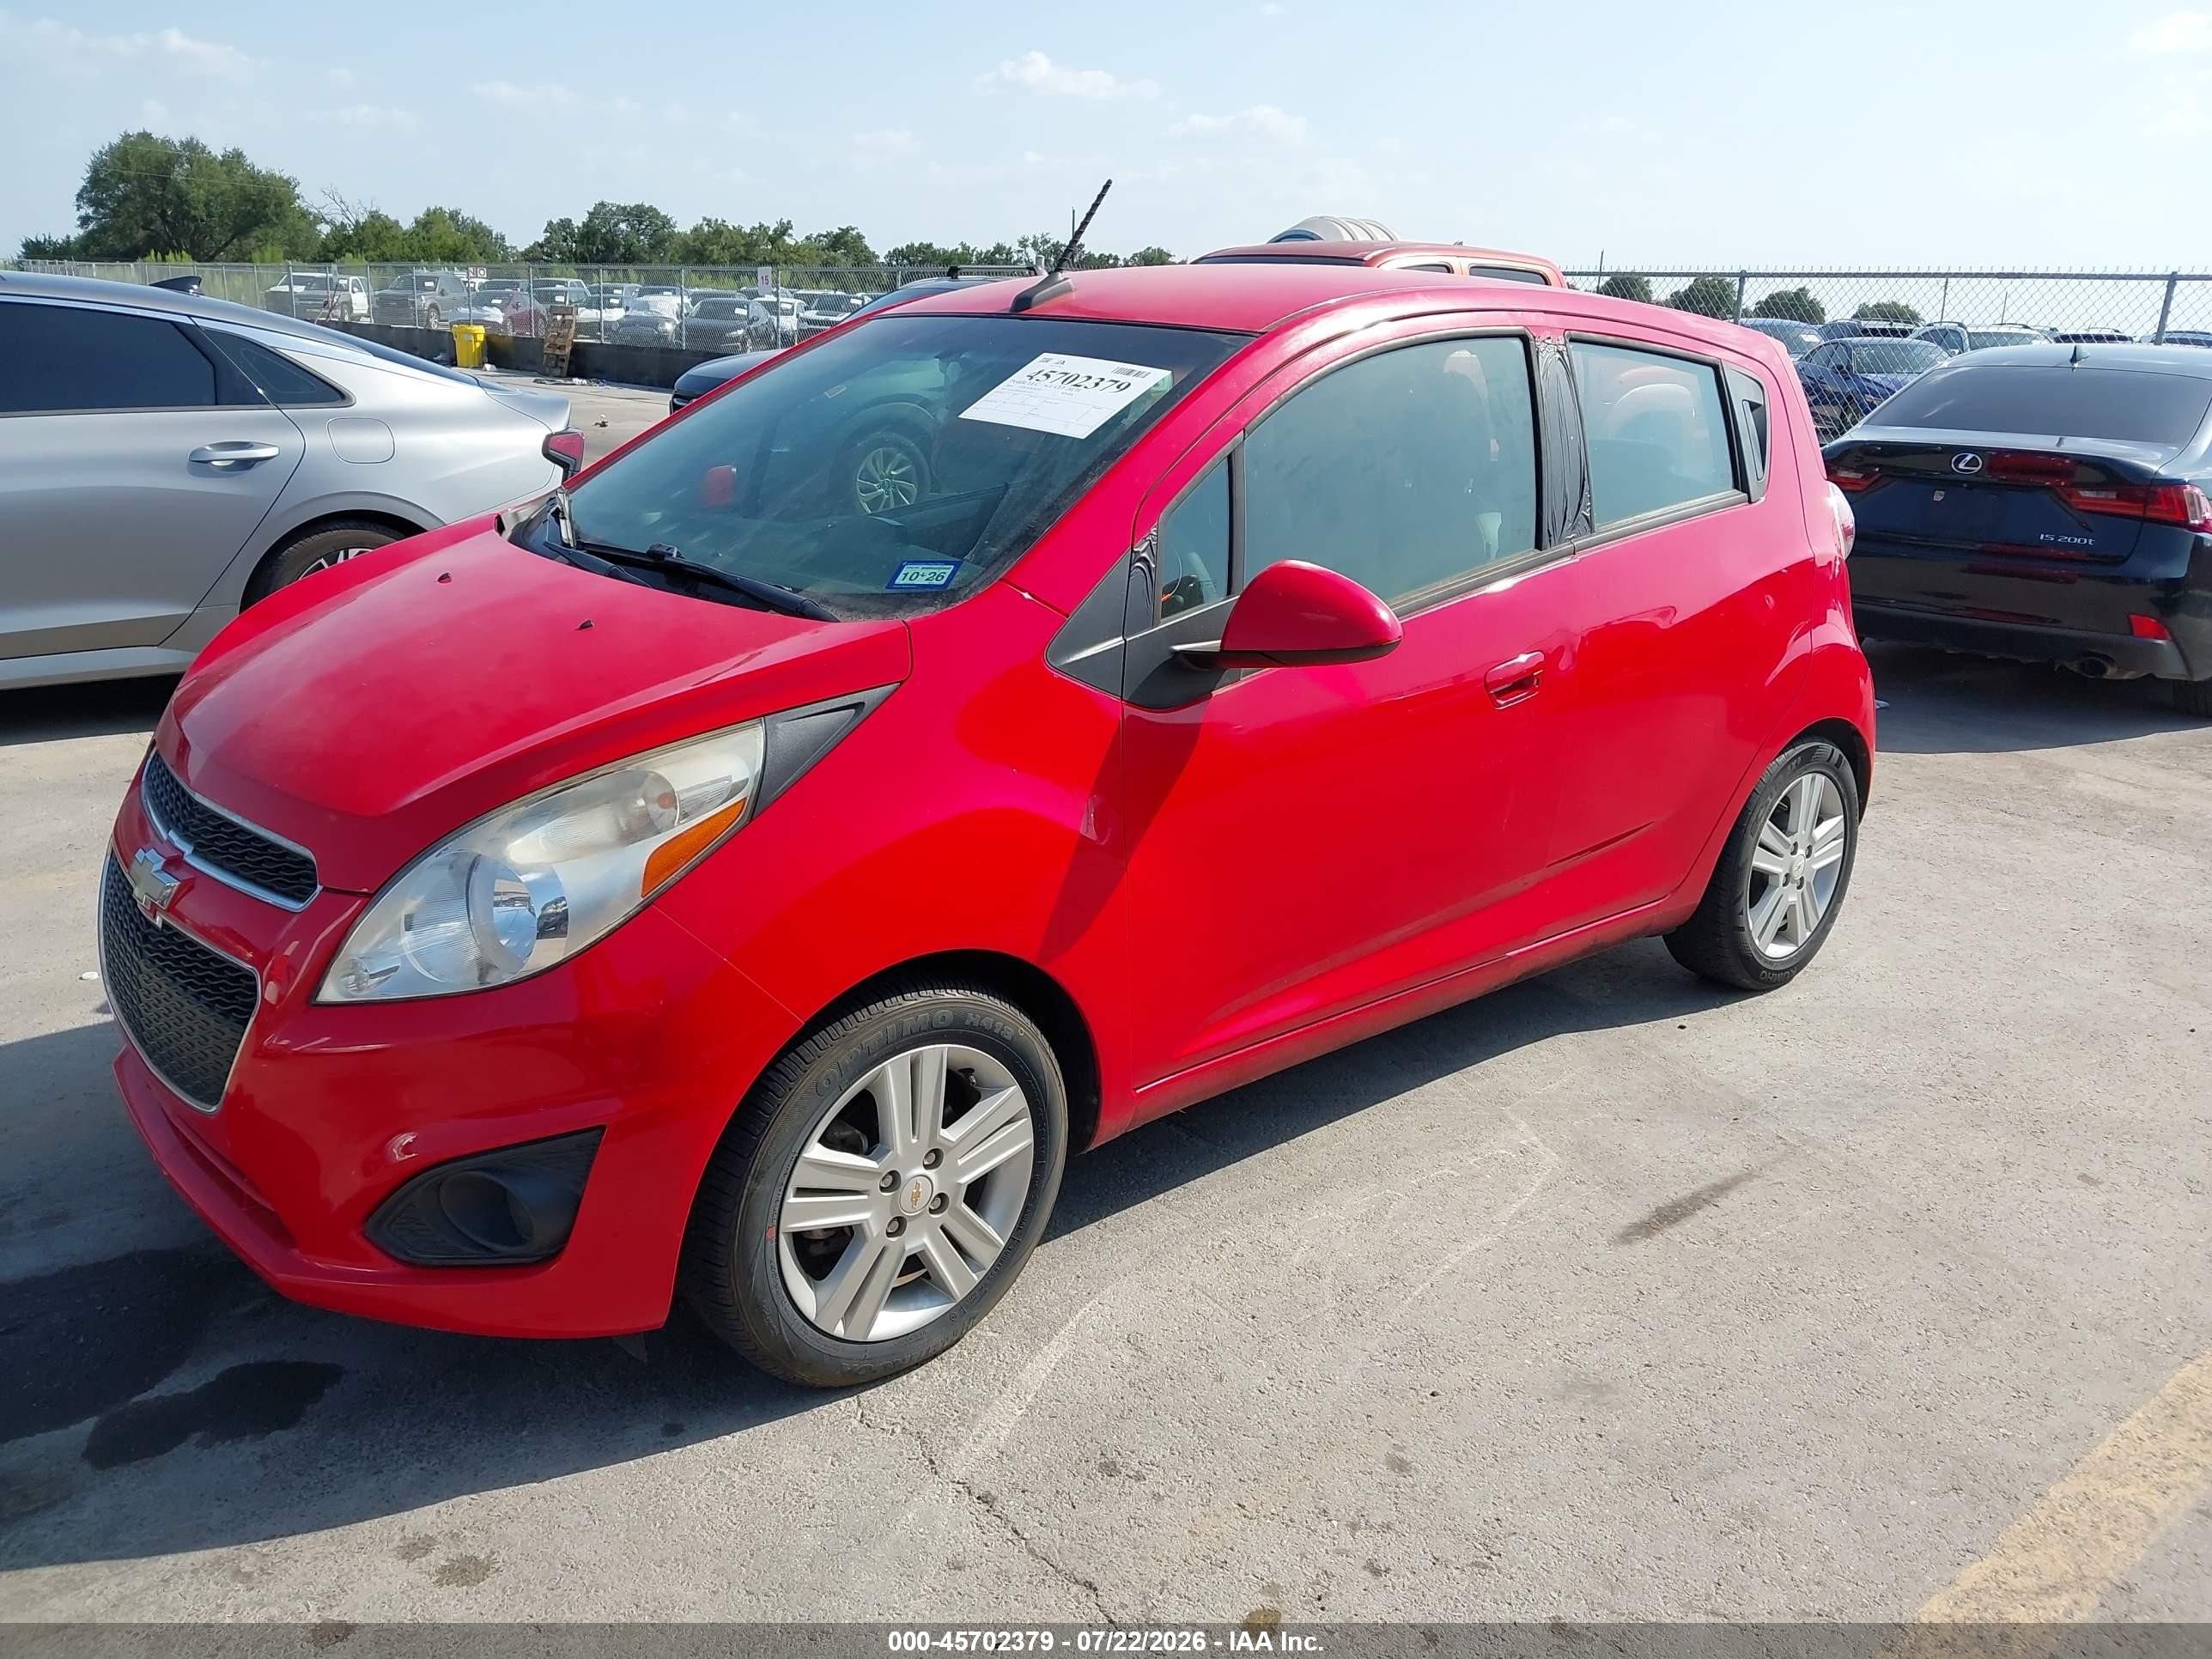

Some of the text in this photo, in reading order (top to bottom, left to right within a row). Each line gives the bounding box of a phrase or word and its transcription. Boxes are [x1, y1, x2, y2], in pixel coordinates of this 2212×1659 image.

[469, 268, 486, 276] NO
[761, 275, 769, 286] 15
[1026, 369, 1132, 392] 45702379
[2057, 535, 2095, 545] 200t
[1760, 966, 1798, 983] KUMHO
[816, 1009, 954, 1097] OPTIMO
